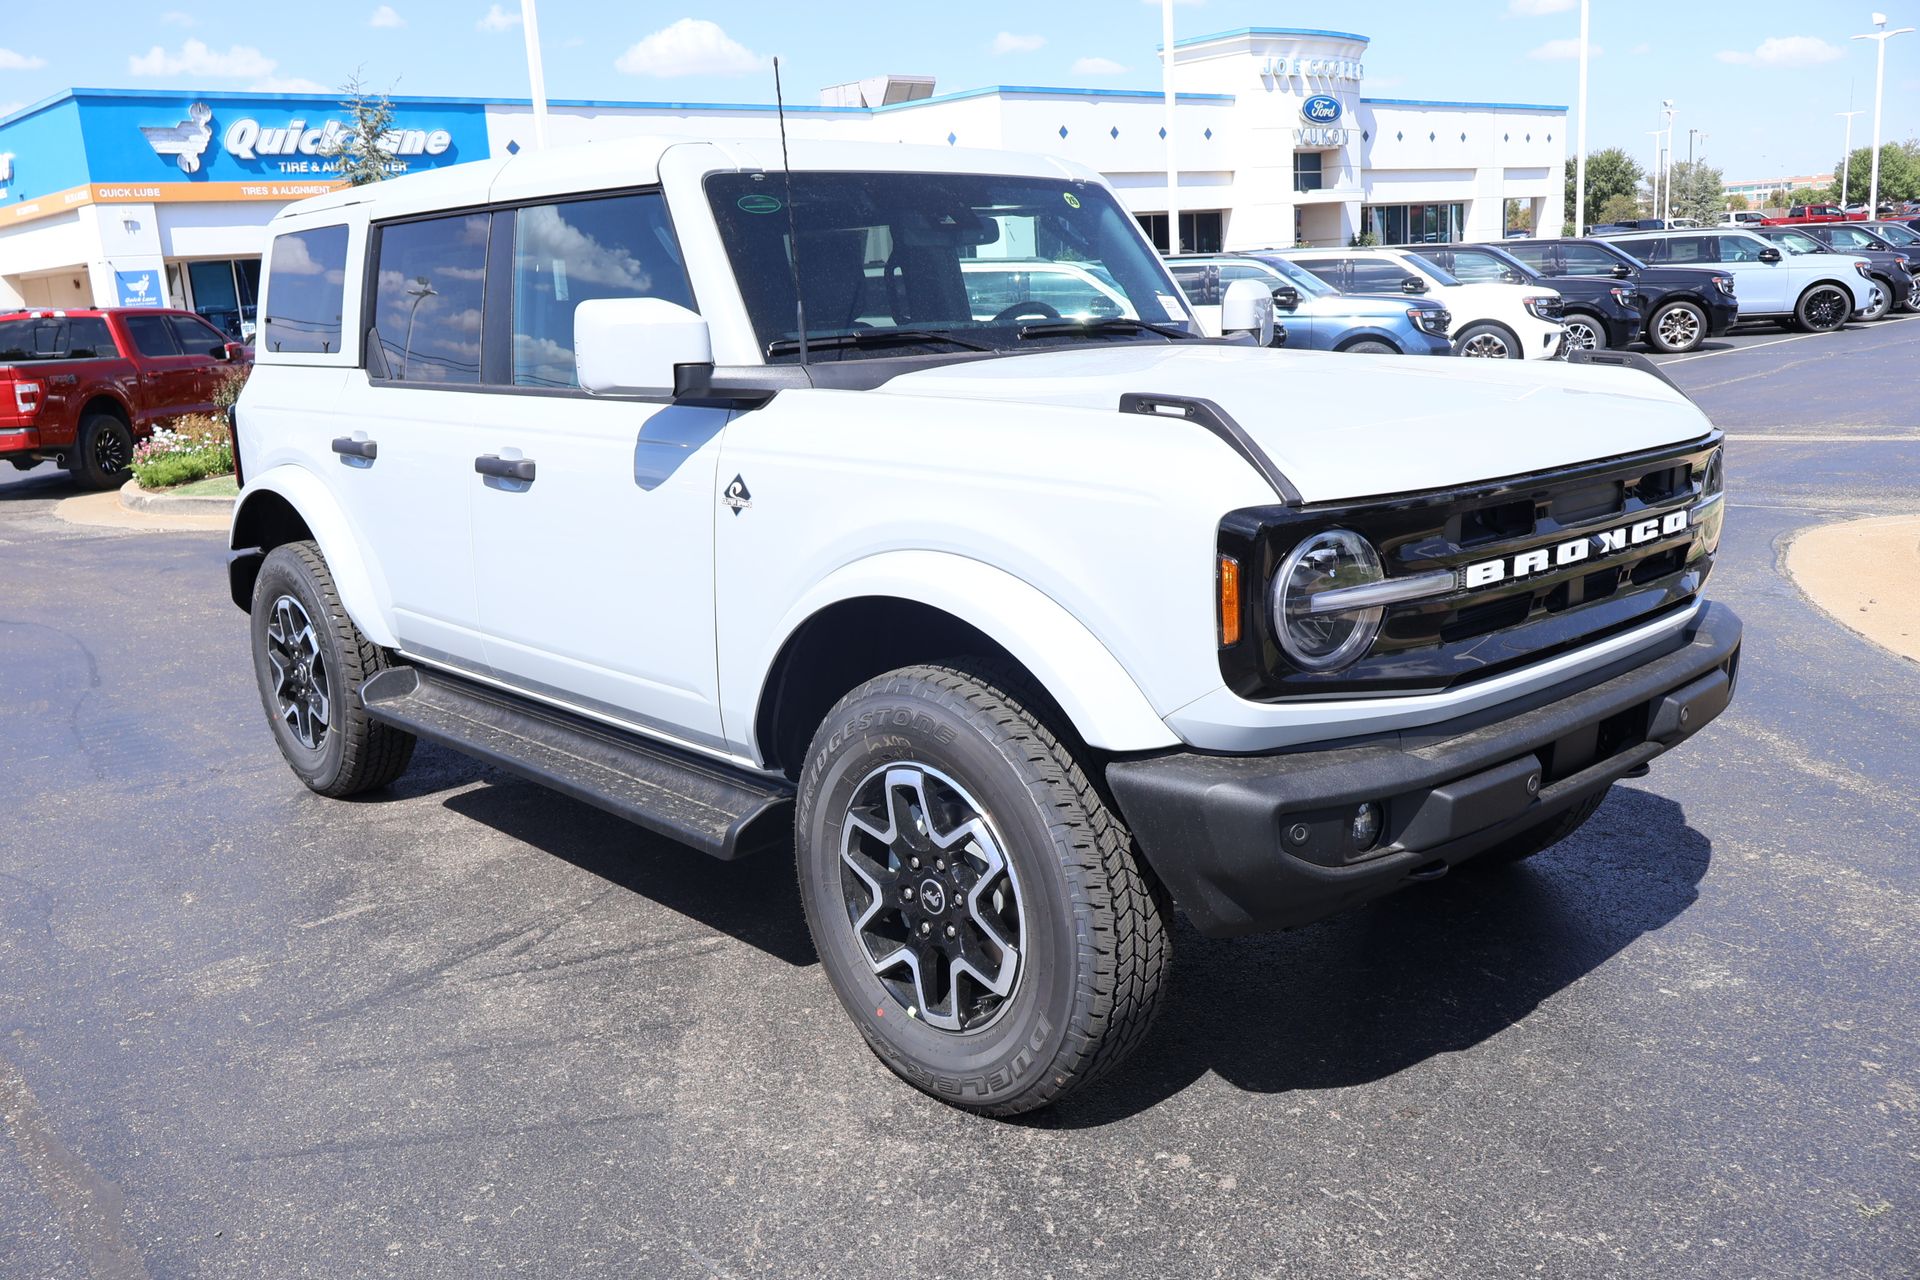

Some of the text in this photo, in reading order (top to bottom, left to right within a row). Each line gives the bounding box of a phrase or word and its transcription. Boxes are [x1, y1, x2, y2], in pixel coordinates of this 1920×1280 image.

[1262, 58, 1364, 80] JOE COOPER
[1311, 99, 1336, 117] Ford
[224, 118, 452, 160] Quick ane
[1297, 128, 1349, 145] YUKON
[278, 161, 308, 173] TIRE
[311, 161, 321, 173] &
[323, 161, 355, 173] AUO
[99, 188, 132, 198] QUICK
[134, 187, 161, 197] LUBE
[240, 185, 331, 196] TIRES & ALIGNMENT
[1466, 510, 1687, 589] BRONCO
[905, 1008, 1052, 1096] DUELER
